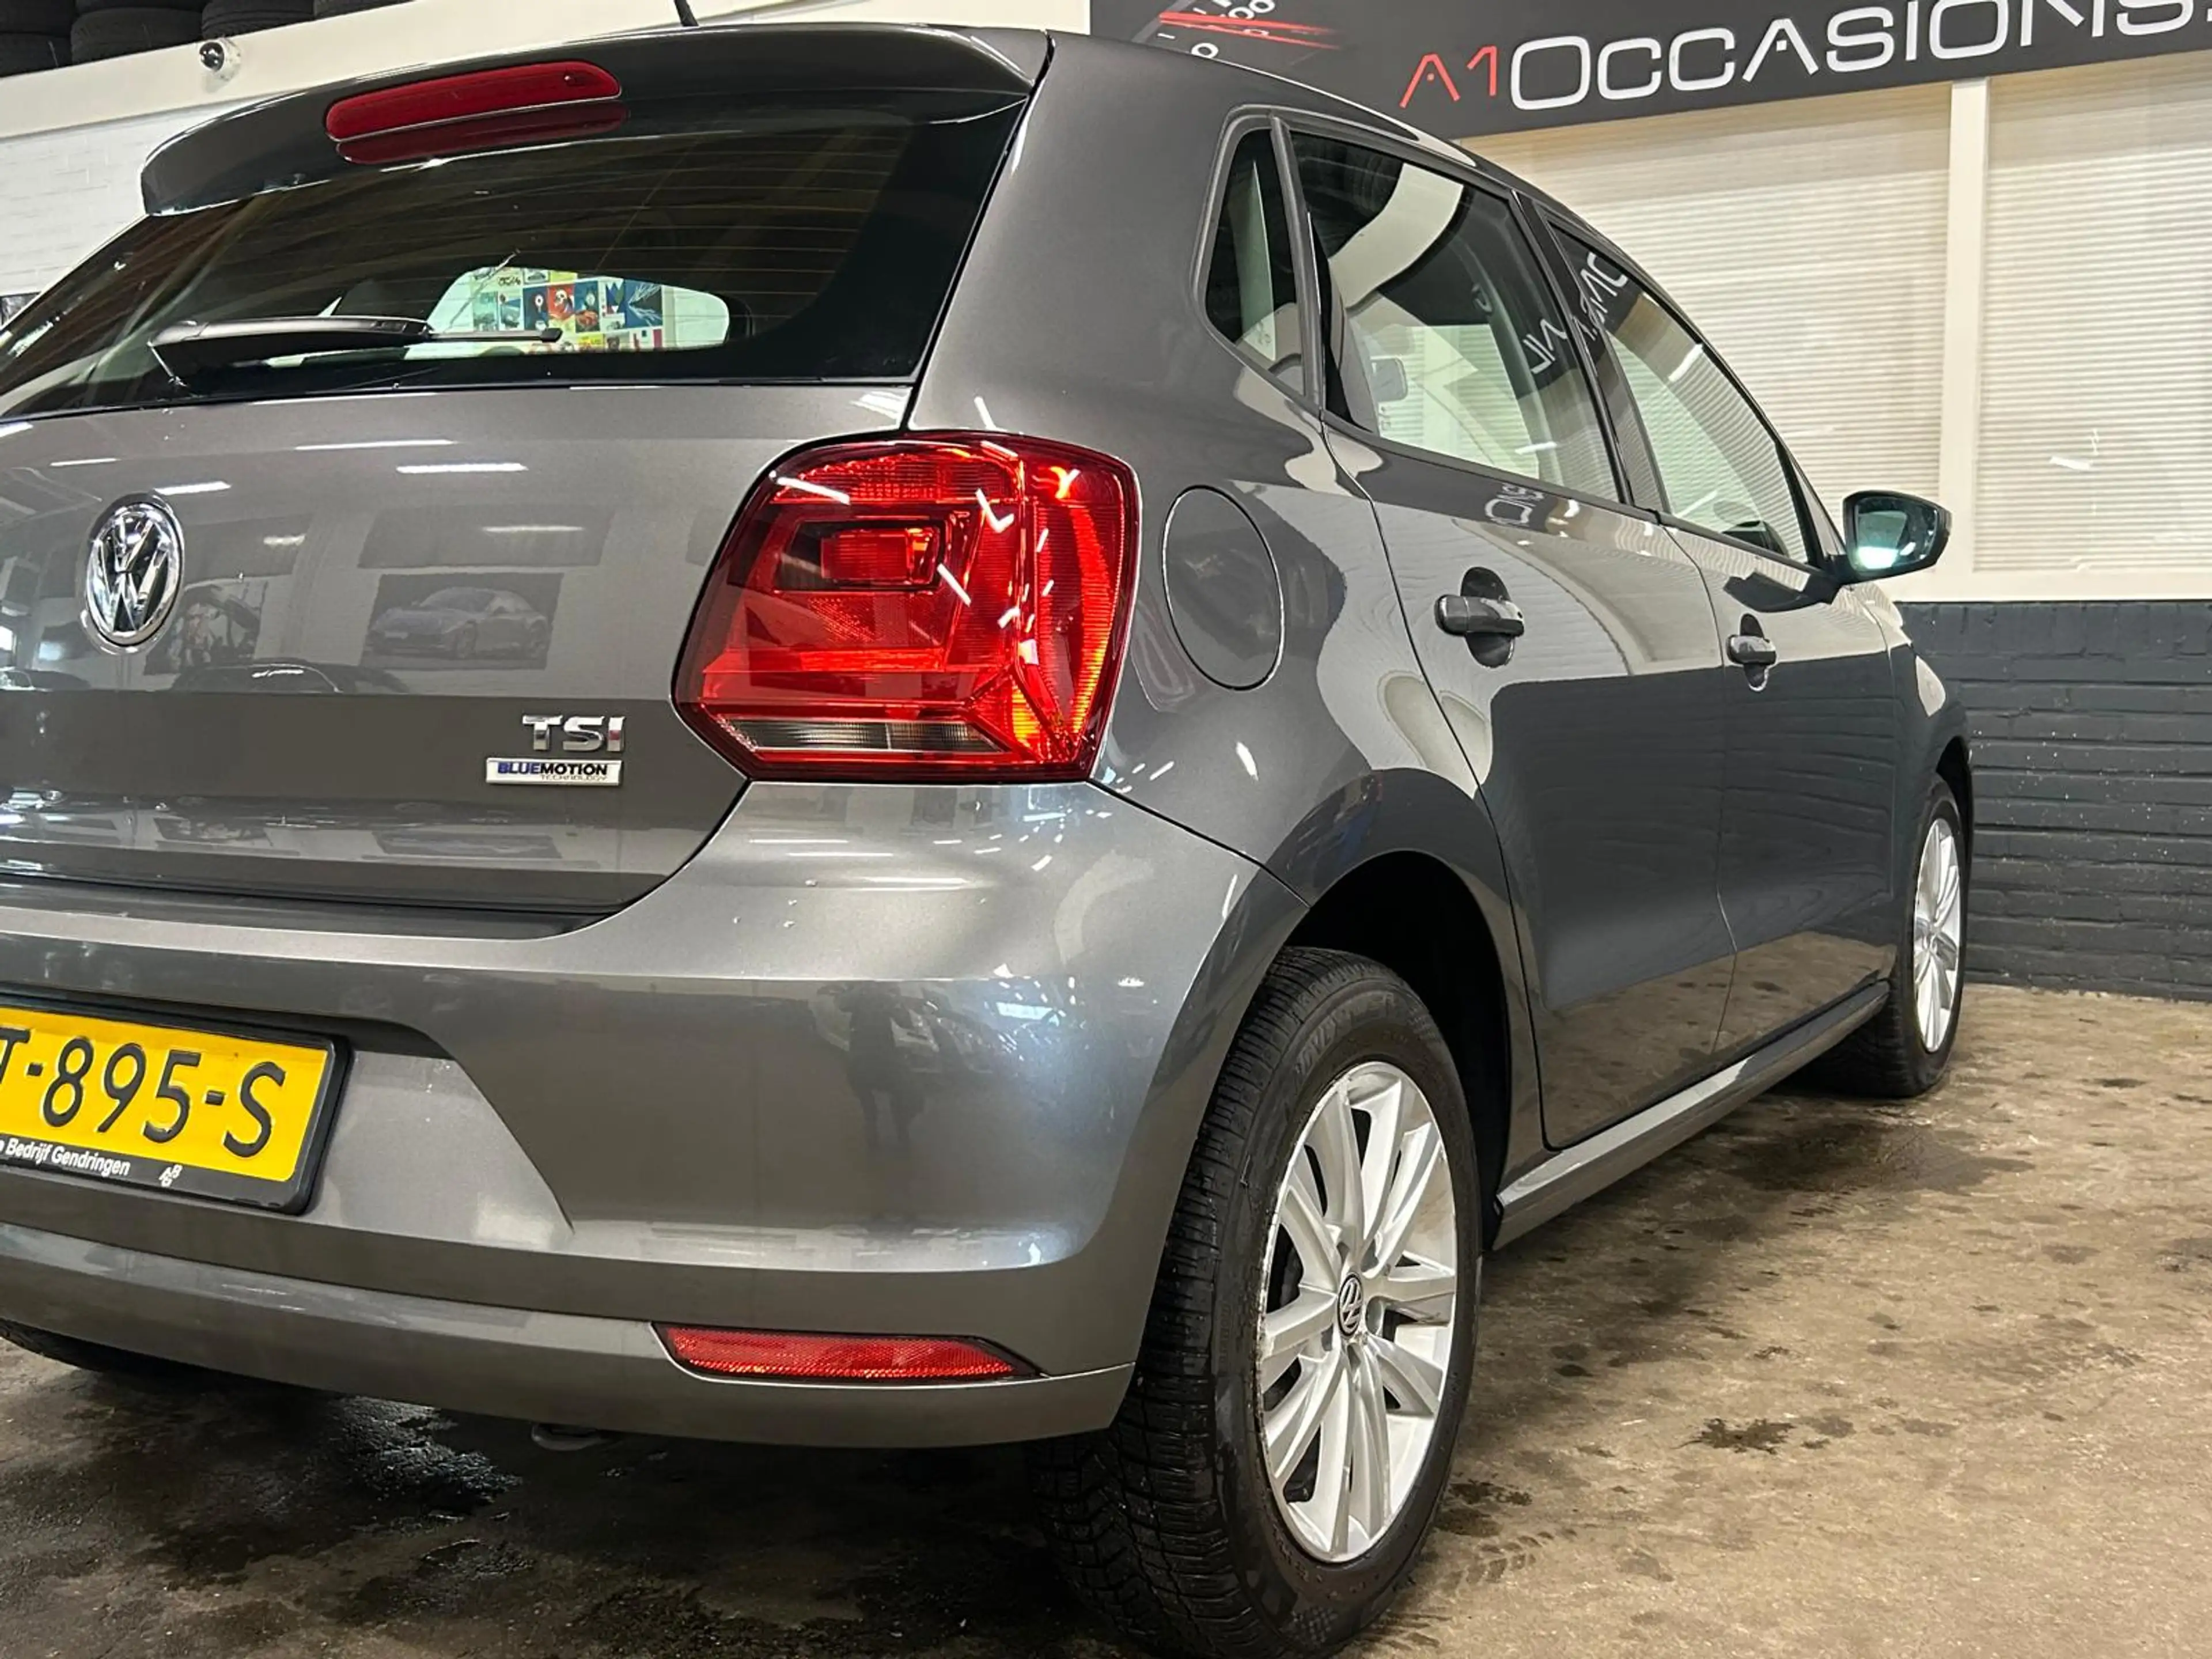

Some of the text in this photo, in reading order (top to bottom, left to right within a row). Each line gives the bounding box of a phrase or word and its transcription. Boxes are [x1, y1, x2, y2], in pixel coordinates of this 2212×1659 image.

[522, 715, 626, 751] TSI
[497, 762, 607, 775] BLUEMOTION
[5, 1137, 53, 1165] Bedrijf
[51, 1145, 131, 1177] Gendringen
